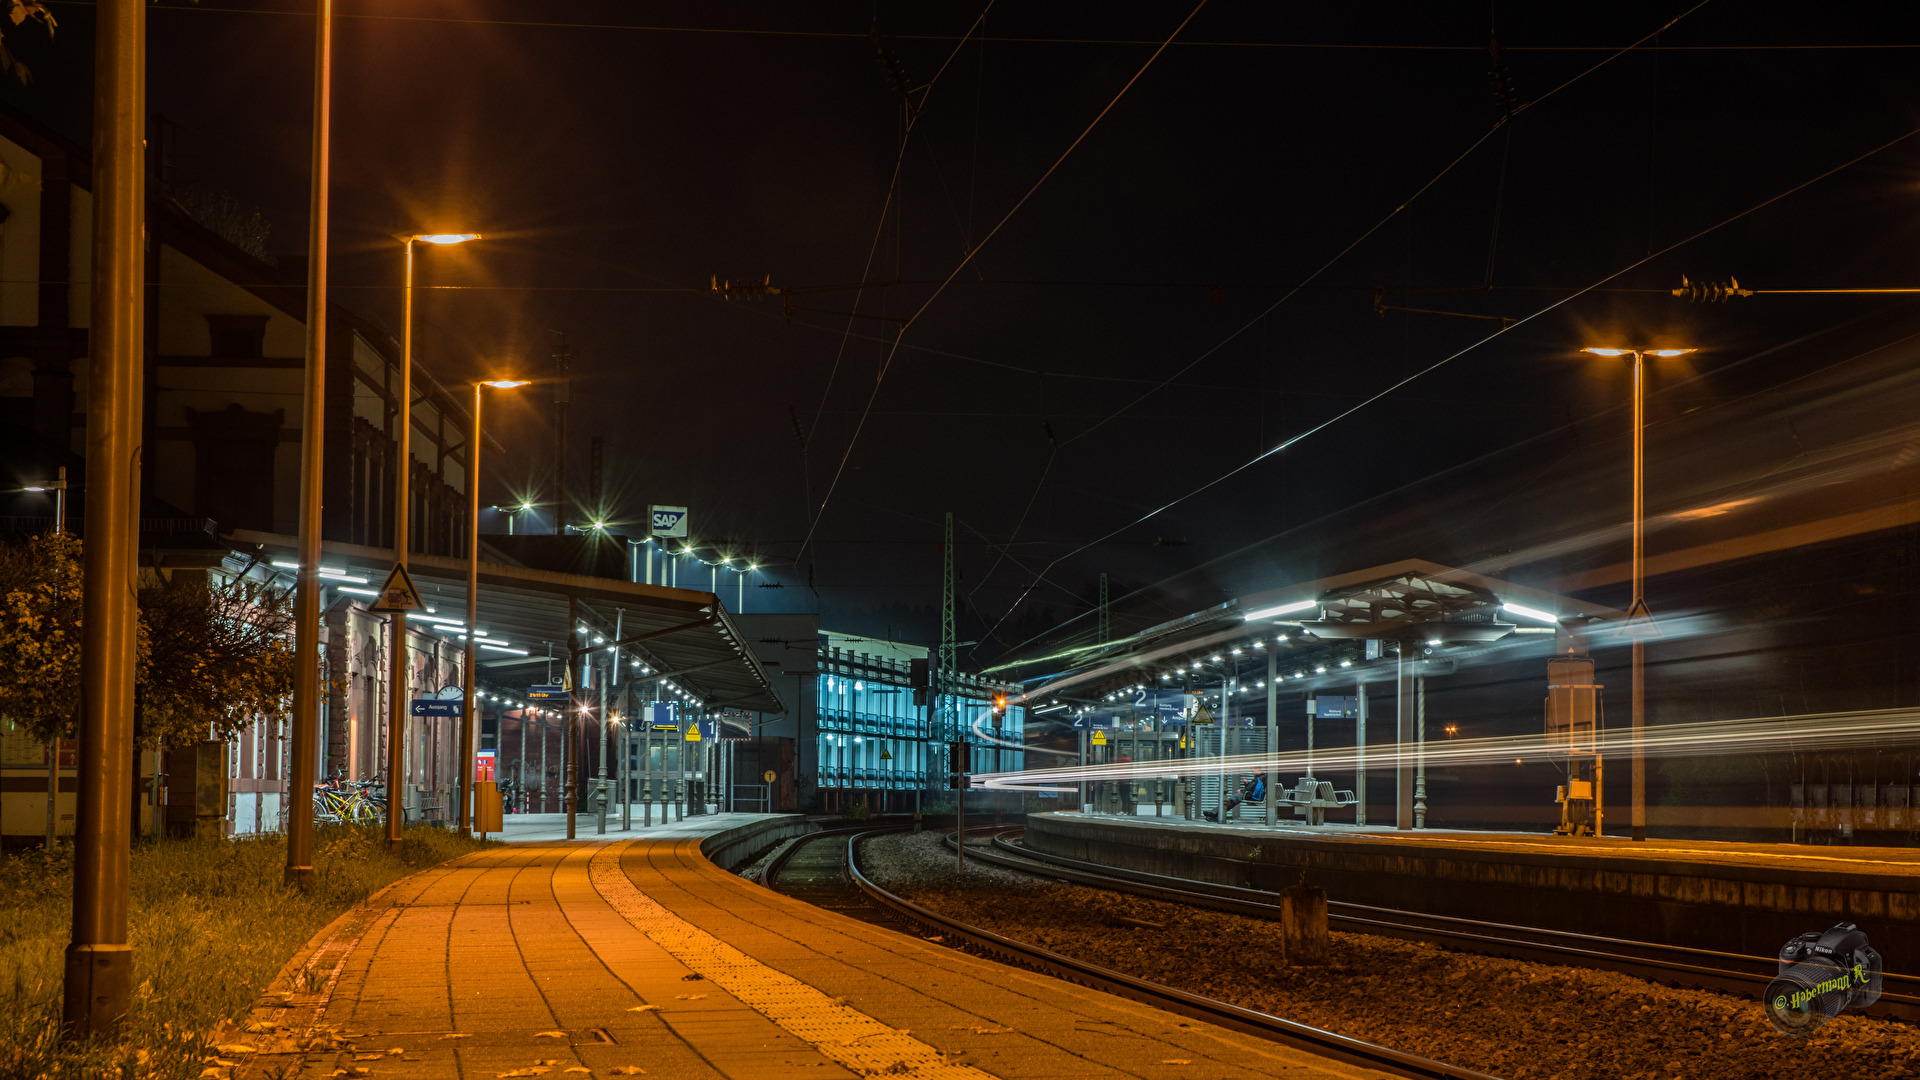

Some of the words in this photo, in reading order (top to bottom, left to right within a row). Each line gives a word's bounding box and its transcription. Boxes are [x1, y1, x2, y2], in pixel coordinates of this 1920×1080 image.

[653, 513, 678, 527] SAP
[1135, 690, 1146, 707] 2
[666, 703, 674, 721] 1
[1073, 713, 1083, 727] 2
[1245, 716, 1254, 729] 3
[707, 720, 714, 735] 1
